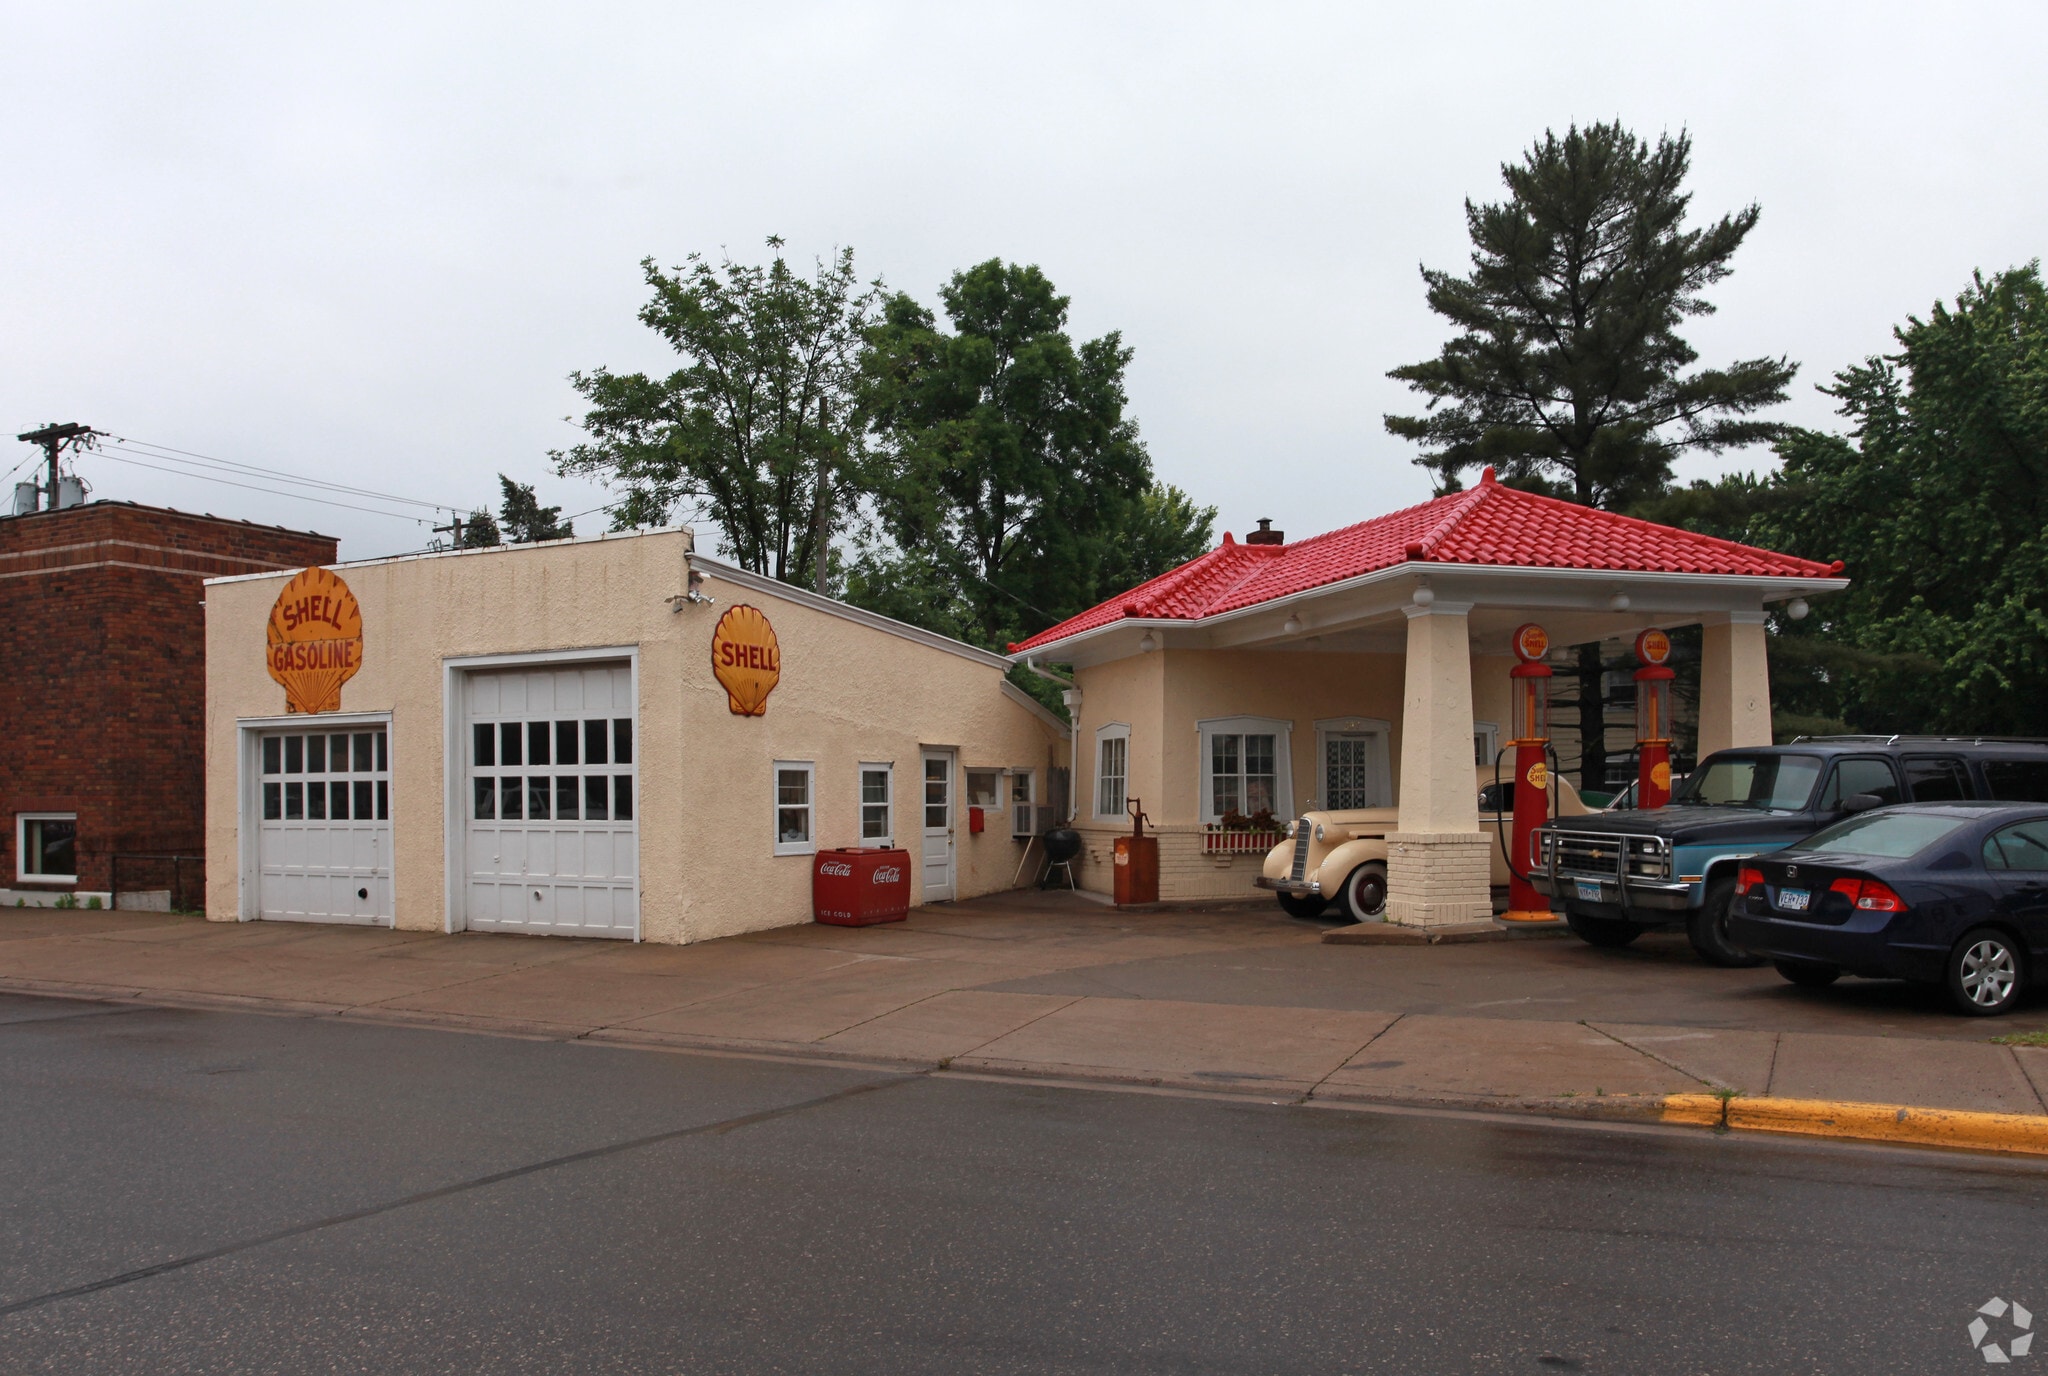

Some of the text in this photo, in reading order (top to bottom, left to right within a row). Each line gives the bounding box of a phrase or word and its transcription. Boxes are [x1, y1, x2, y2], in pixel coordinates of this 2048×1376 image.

[283, 595, 342, 631] SHELL
[273, 641, 354, 672] GASOLINE
[721, 641, 777, 672] SHELL
[1525, 639, 1545, 649] SHELL
[1646, 640, 1667, 650] SHELL
